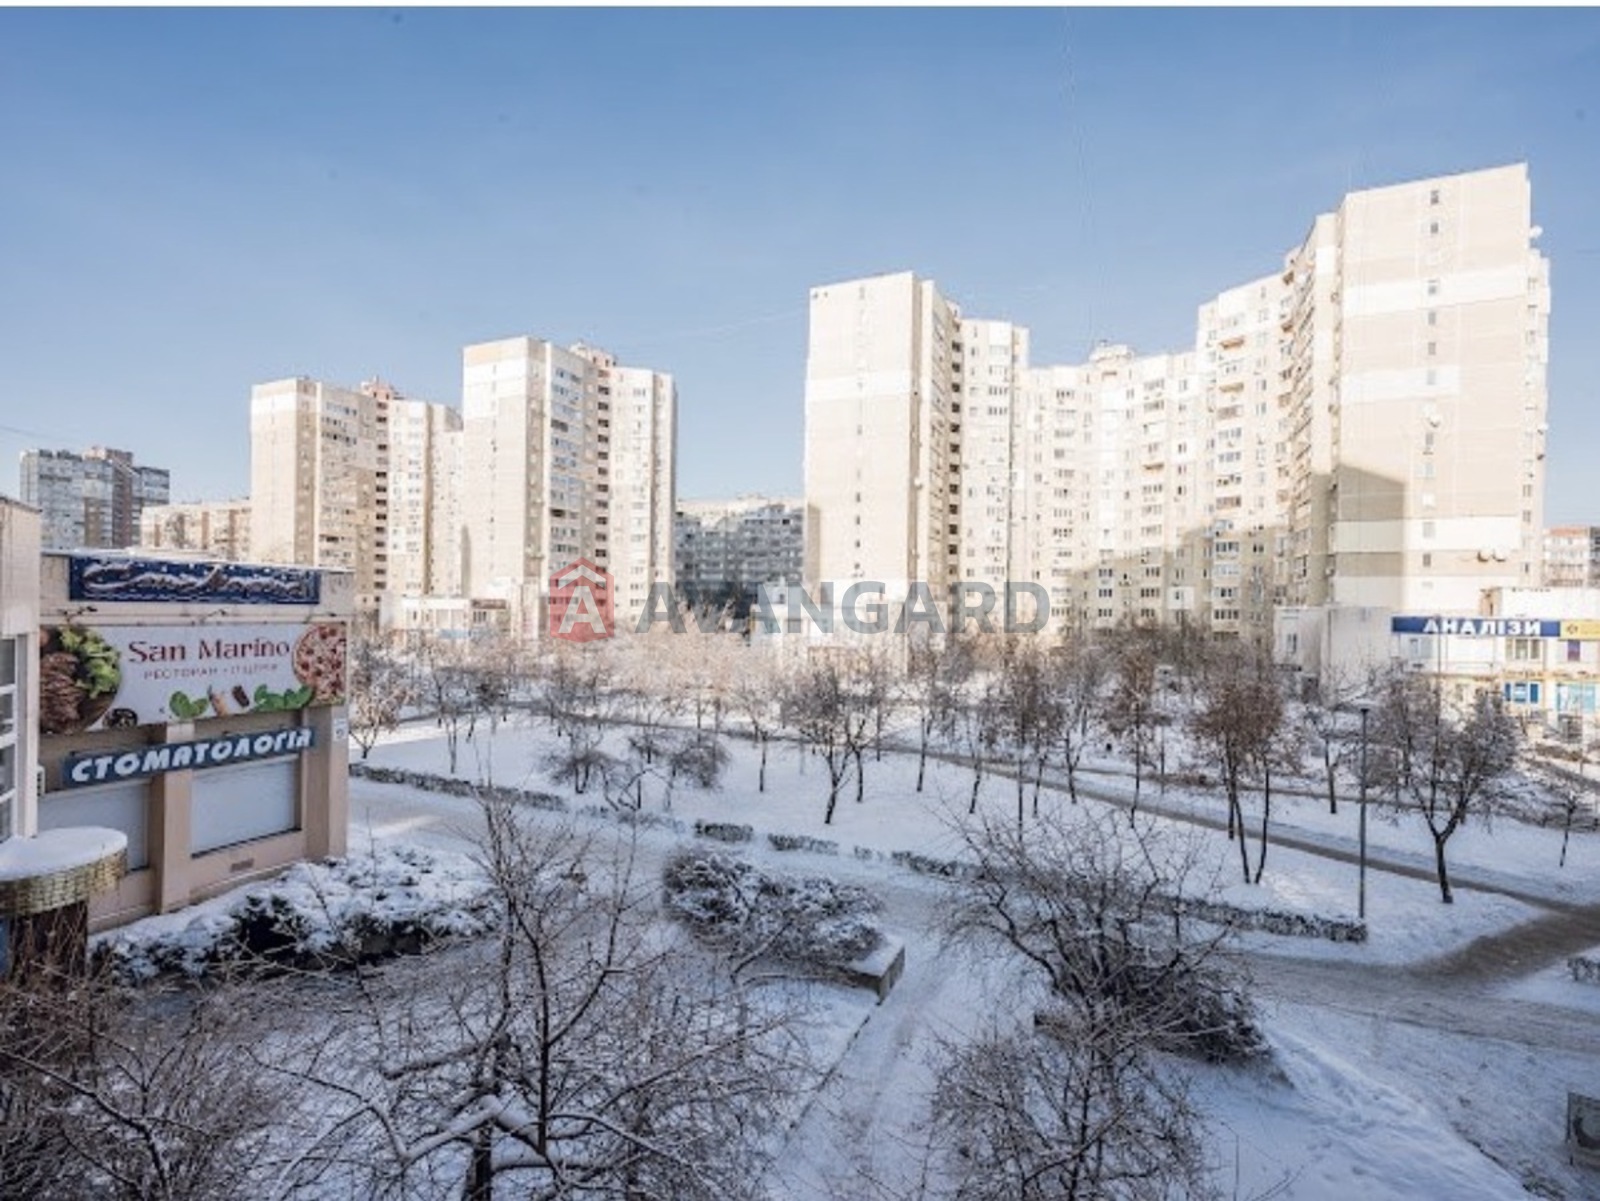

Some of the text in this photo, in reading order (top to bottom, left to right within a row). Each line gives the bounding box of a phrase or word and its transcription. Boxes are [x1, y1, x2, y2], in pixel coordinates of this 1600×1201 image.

[1423, 618, 1541, 636] АНАЛІЗИ
[128, 638, 291, 663] San Marino
[71, 729, 313, 783] СТОМАТОЛОГІЯ
